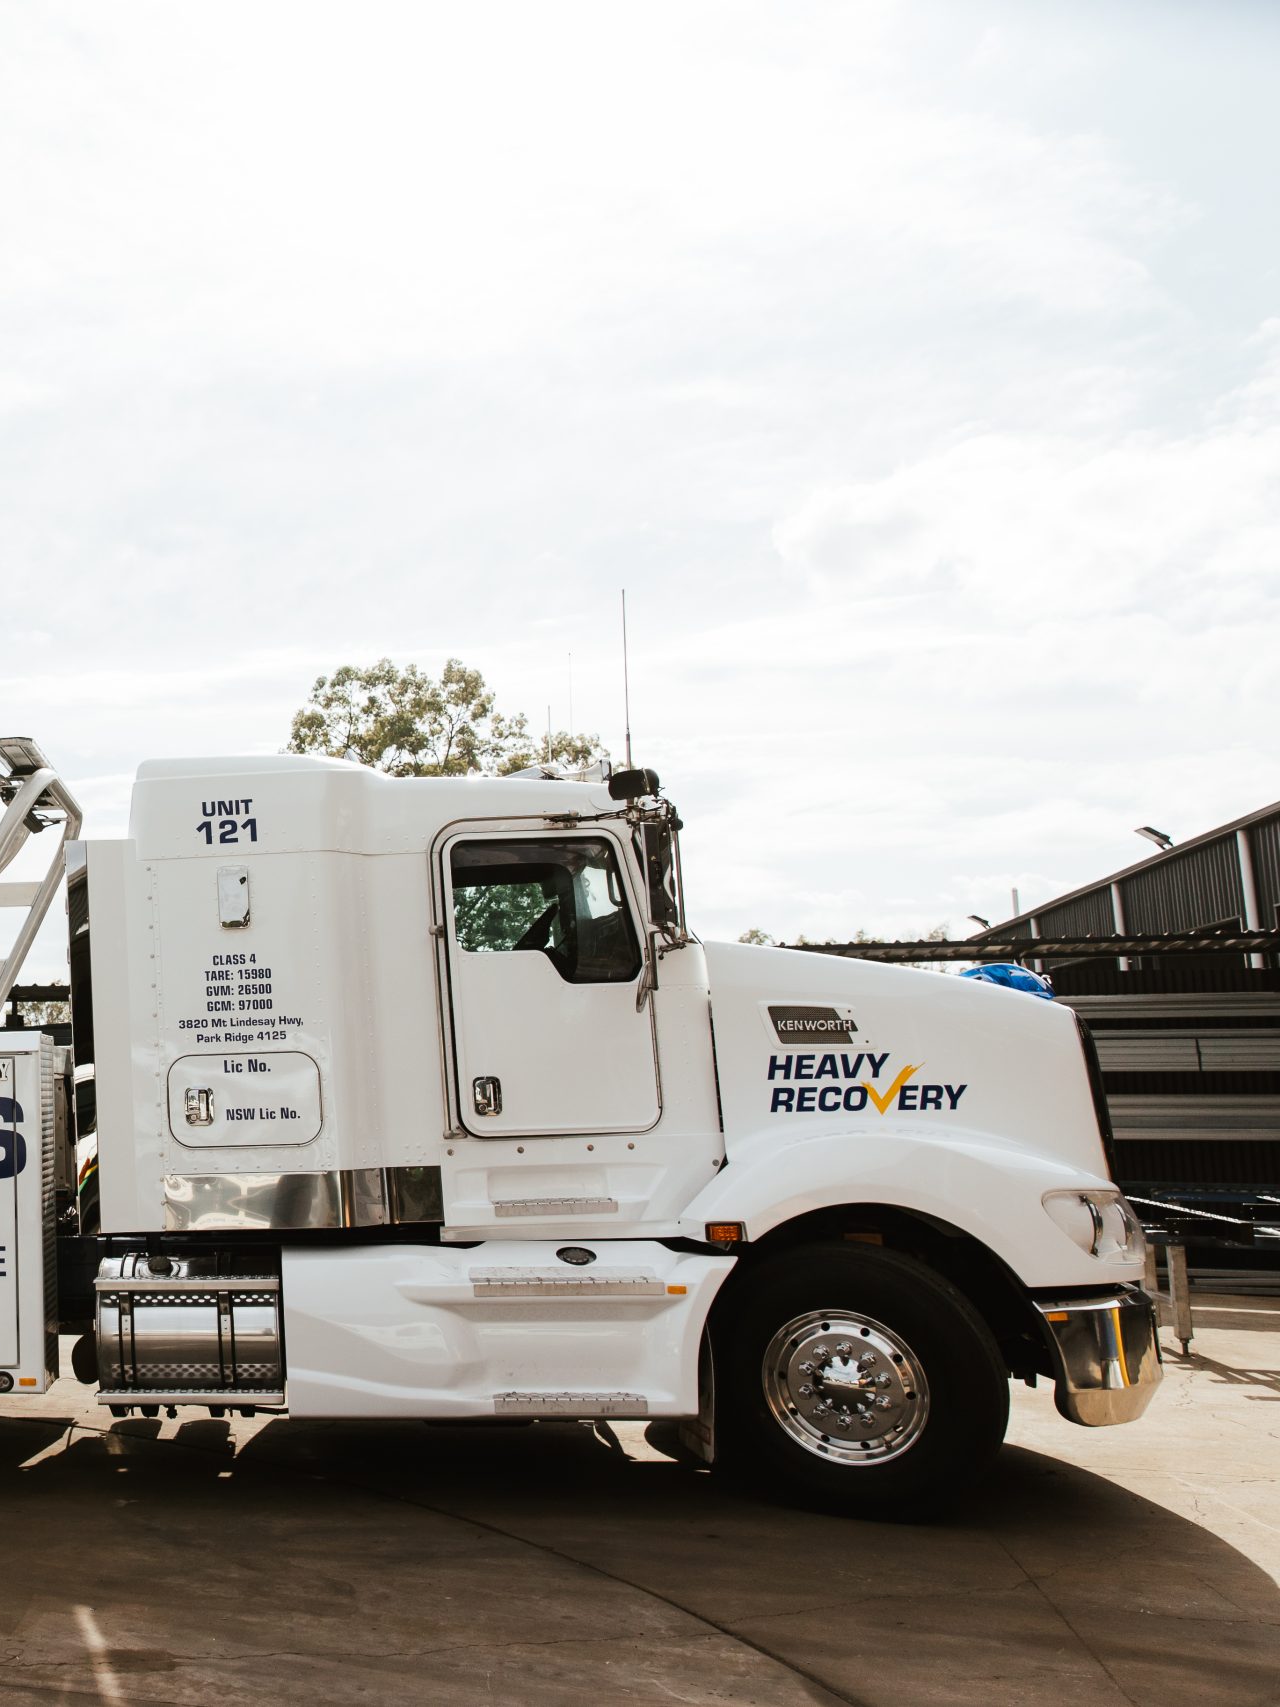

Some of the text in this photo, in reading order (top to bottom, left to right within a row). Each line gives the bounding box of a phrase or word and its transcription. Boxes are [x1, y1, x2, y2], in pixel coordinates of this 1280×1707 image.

[201, 798, 253, 817] UNIT
[196, 818, 258, 845] 121
[212, 953, 257, 966] CLASS 4
[204, 968, 272, 981] TARE: 15980
[206, 983, 272, 997] GVM: 26500
[206, 998, 273, 1012] GCM: 97000
[178, 1015, 304, 1029] 3820 Mt Lindesay Hwy,
[777, 1019, 852, 1032] KENWORTH
[196, 1030, 287, 1044] Park Ridge 4125
[223, 1058, 271, 1074] Lic No.
[767, 1053, 890, 1081] HEAVY
[770, 1065, 968, 1115] RECOVERY
[226, 1107, 301, 1121] NSW Lic No.
